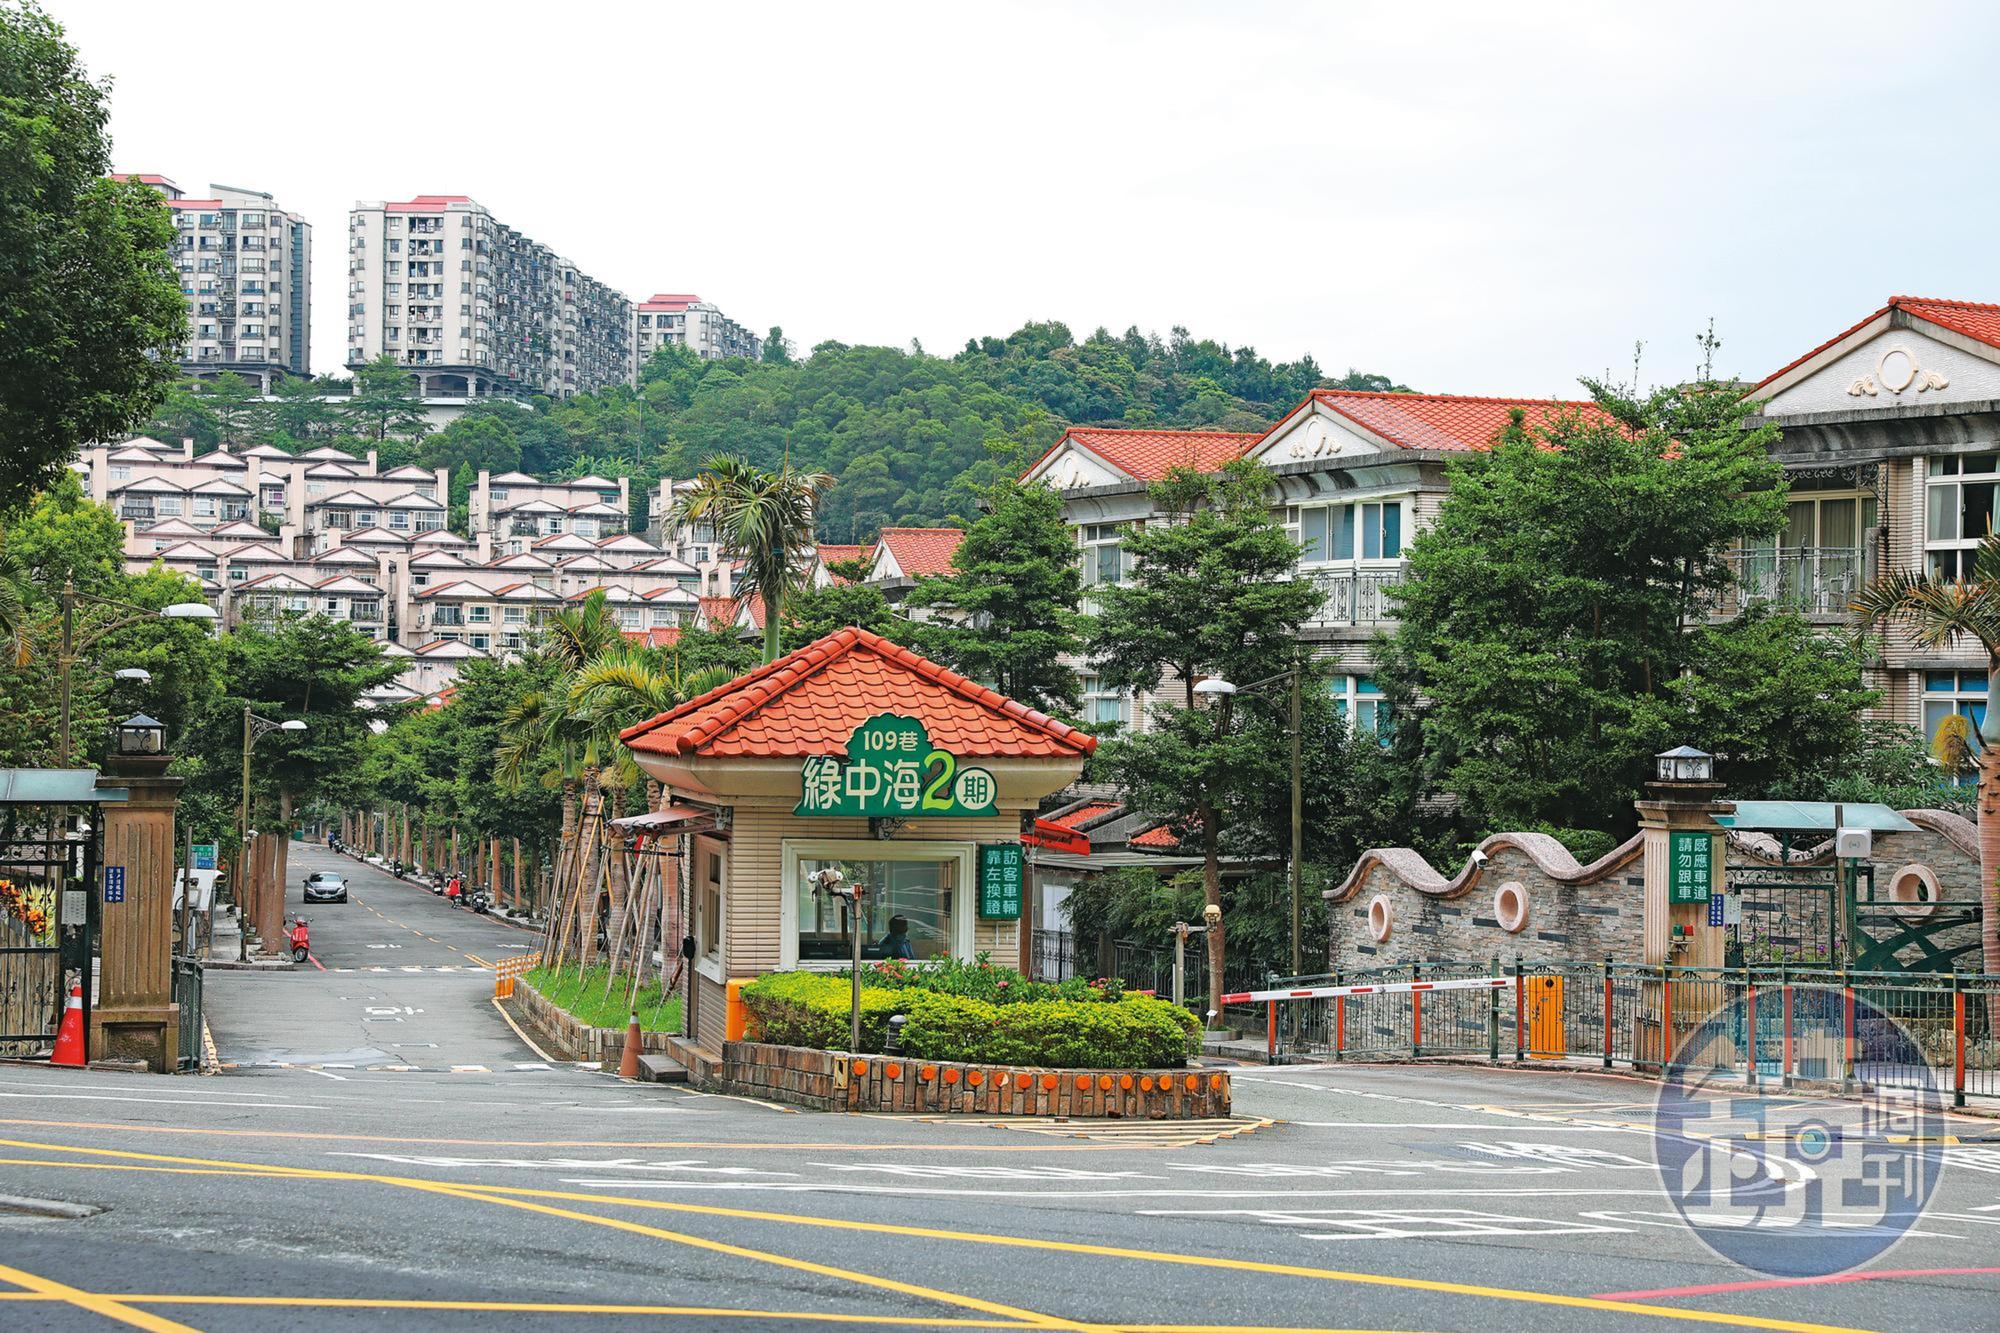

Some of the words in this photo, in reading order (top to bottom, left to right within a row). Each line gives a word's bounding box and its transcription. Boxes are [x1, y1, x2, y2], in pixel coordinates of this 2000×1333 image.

[863, 731, 918, 751] 109巷
[802, 750, 990, 811] 綠中海2期
[986, 850, 1001, 915] 靠左換證
[1003, 850, 1018, 915] 訪客車輛
[1678, 837, 1692, 900] 請勿跟車
[1693, 837, 1708, 900] 感應車道
